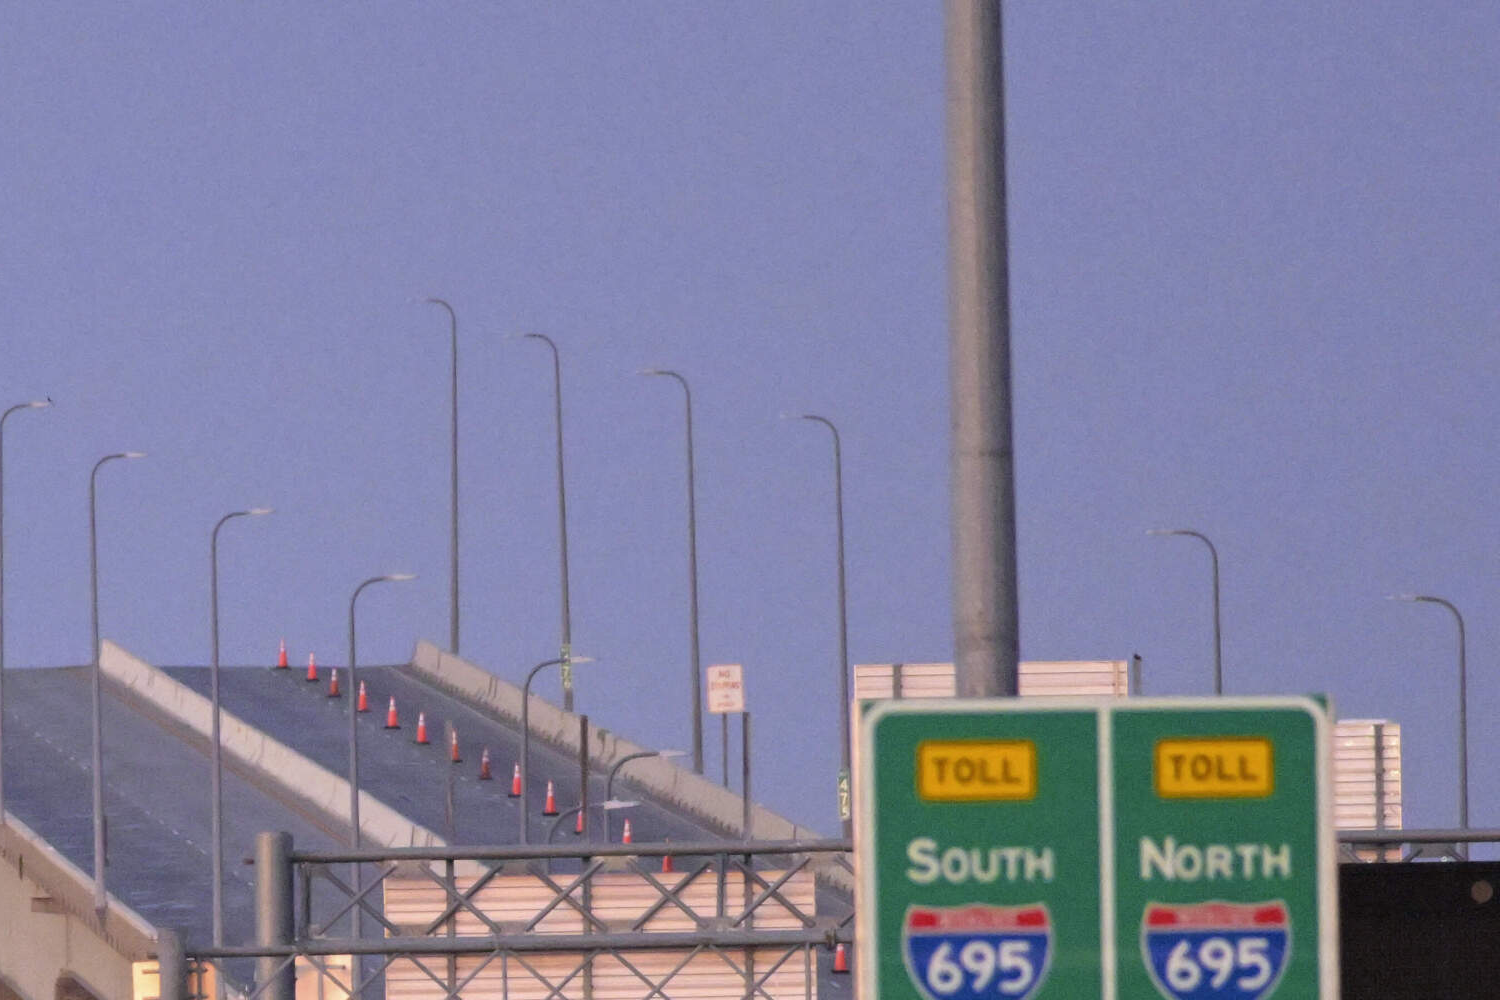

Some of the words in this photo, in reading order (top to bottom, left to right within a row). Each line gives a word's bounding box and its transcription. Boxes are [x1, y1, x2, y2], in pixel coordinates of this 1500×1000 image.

[931, 757, 1022, 784] TOLL
[1169, 754, 1259, 782] TOLL
[927, 941, 1033, 994] 695
[1165, 937, 1271, 992] 695
